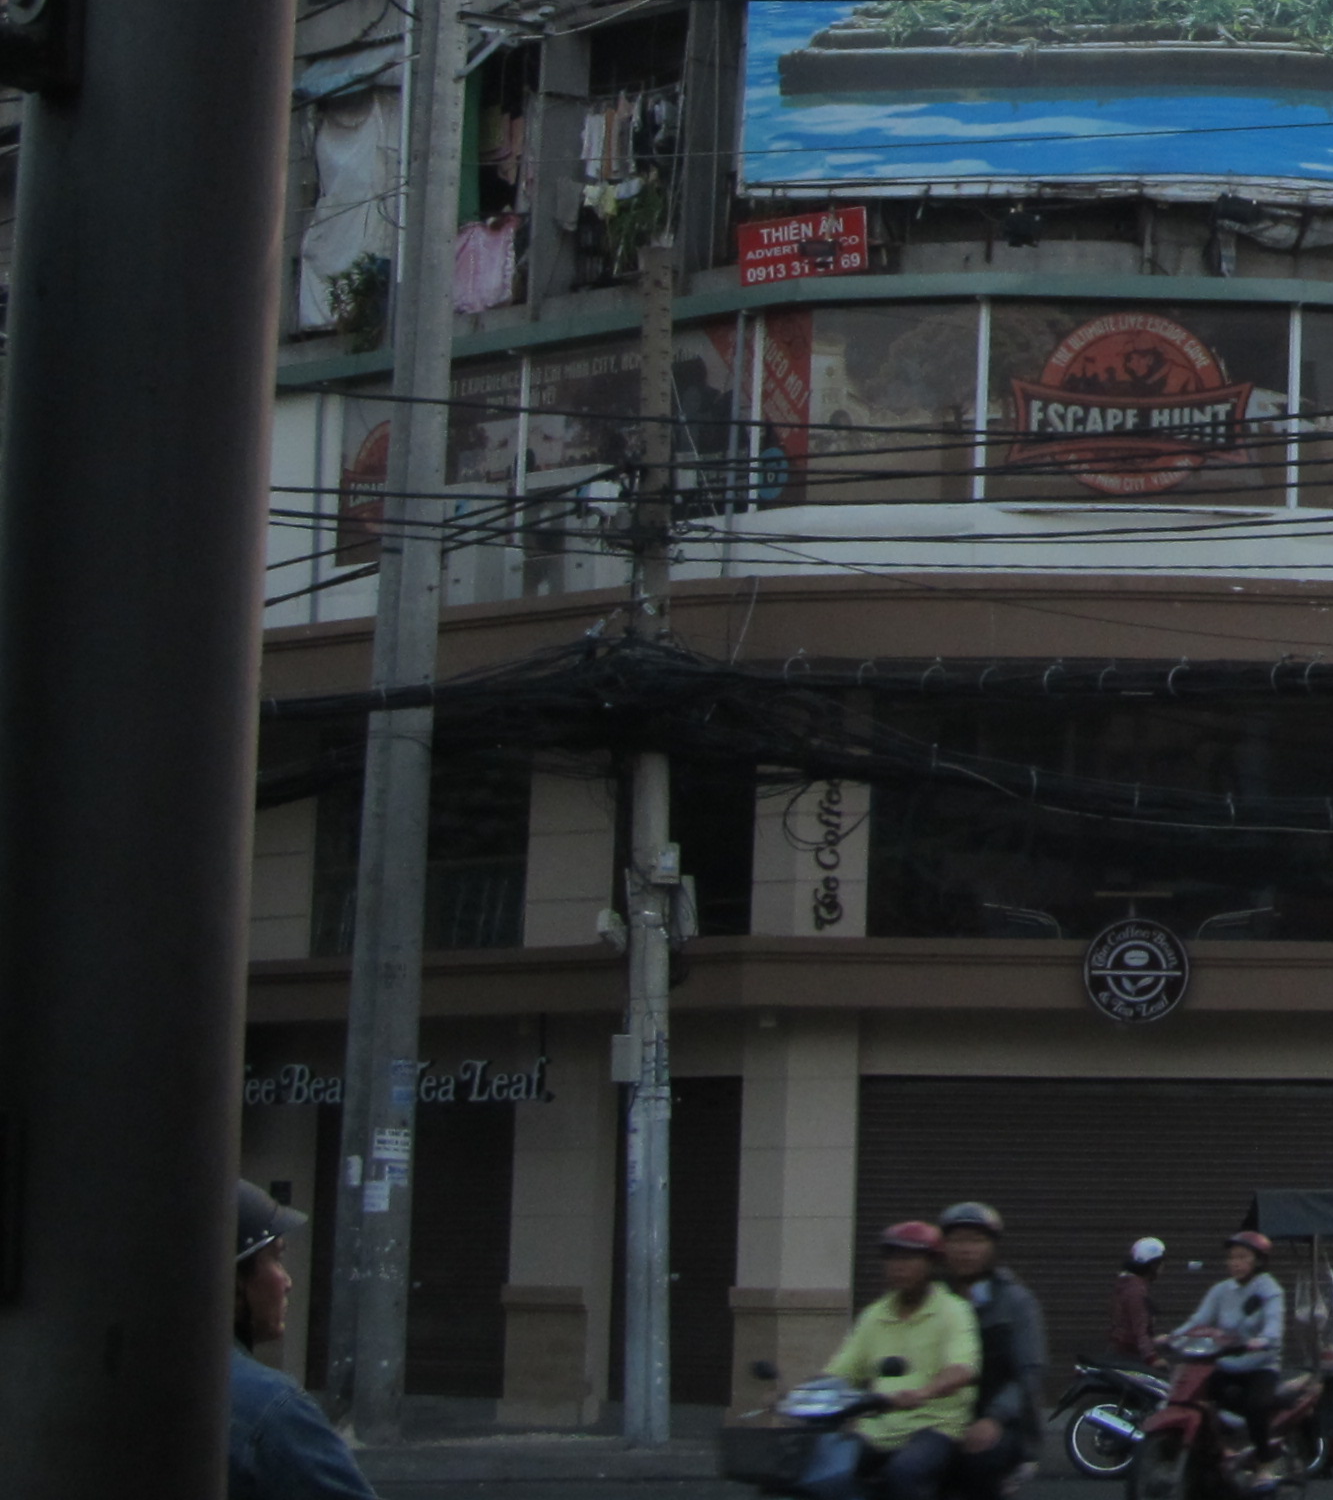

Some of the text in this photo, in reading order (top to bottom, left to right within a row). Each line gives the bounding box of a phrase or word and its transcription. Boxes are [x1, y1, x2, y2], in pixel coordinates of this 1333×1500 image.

[760, 220, 813, 245] THIÊN
[746, 263, 786, 283] 0913
[841, 252, 861, 269] 69
[1030, 399, 1232, 444] ESCAPE HUNT
[1107, 924, 1151, 946] Coffee
[1152, 930, 1178, 969] Bean
[280, 1063, 344, 1104] Bea
[460, 1056, 547, 1102] Leaf
